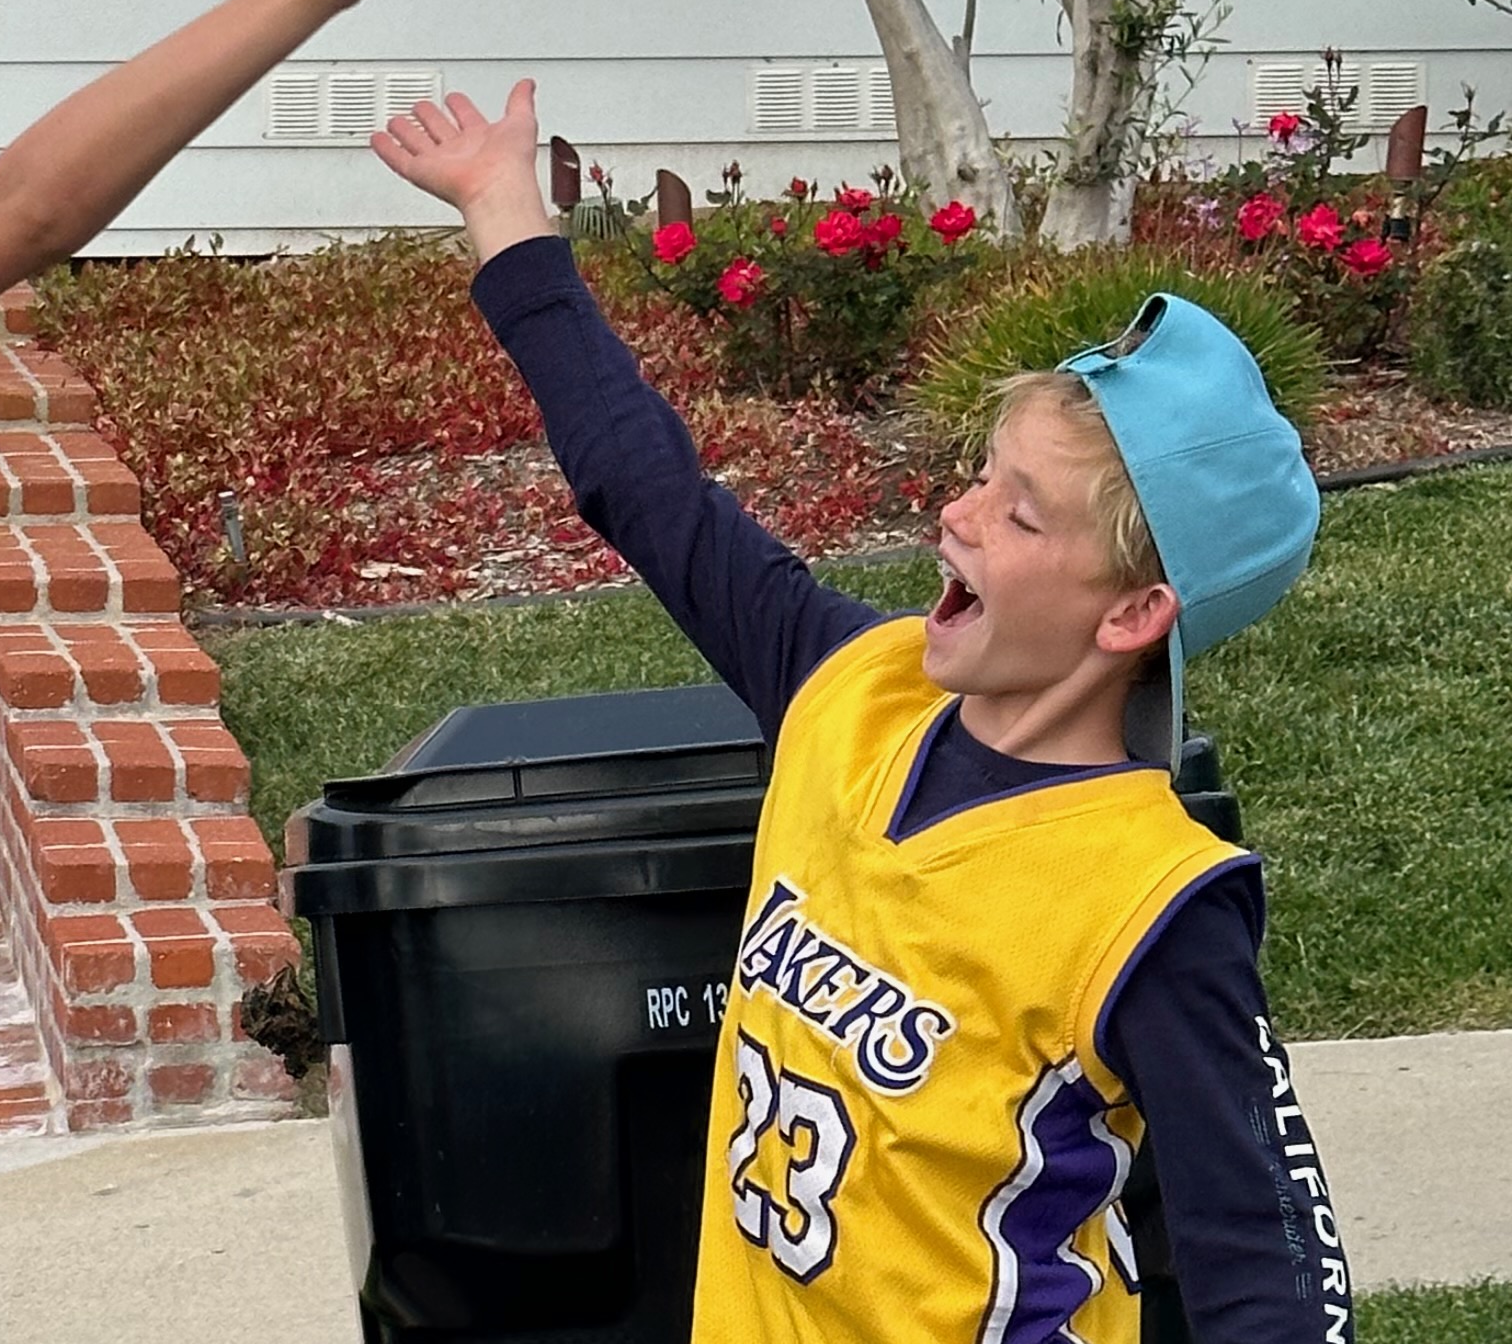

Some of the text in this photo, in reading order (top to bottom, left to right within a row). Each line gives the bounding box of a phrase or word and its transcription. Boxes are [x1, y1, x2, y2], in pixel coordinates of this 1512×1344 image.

[646, 985, 690, 1029] RPC
[738, 877, 954, 1094] LAKERS
[728, 1022, 858, 1287] 23
